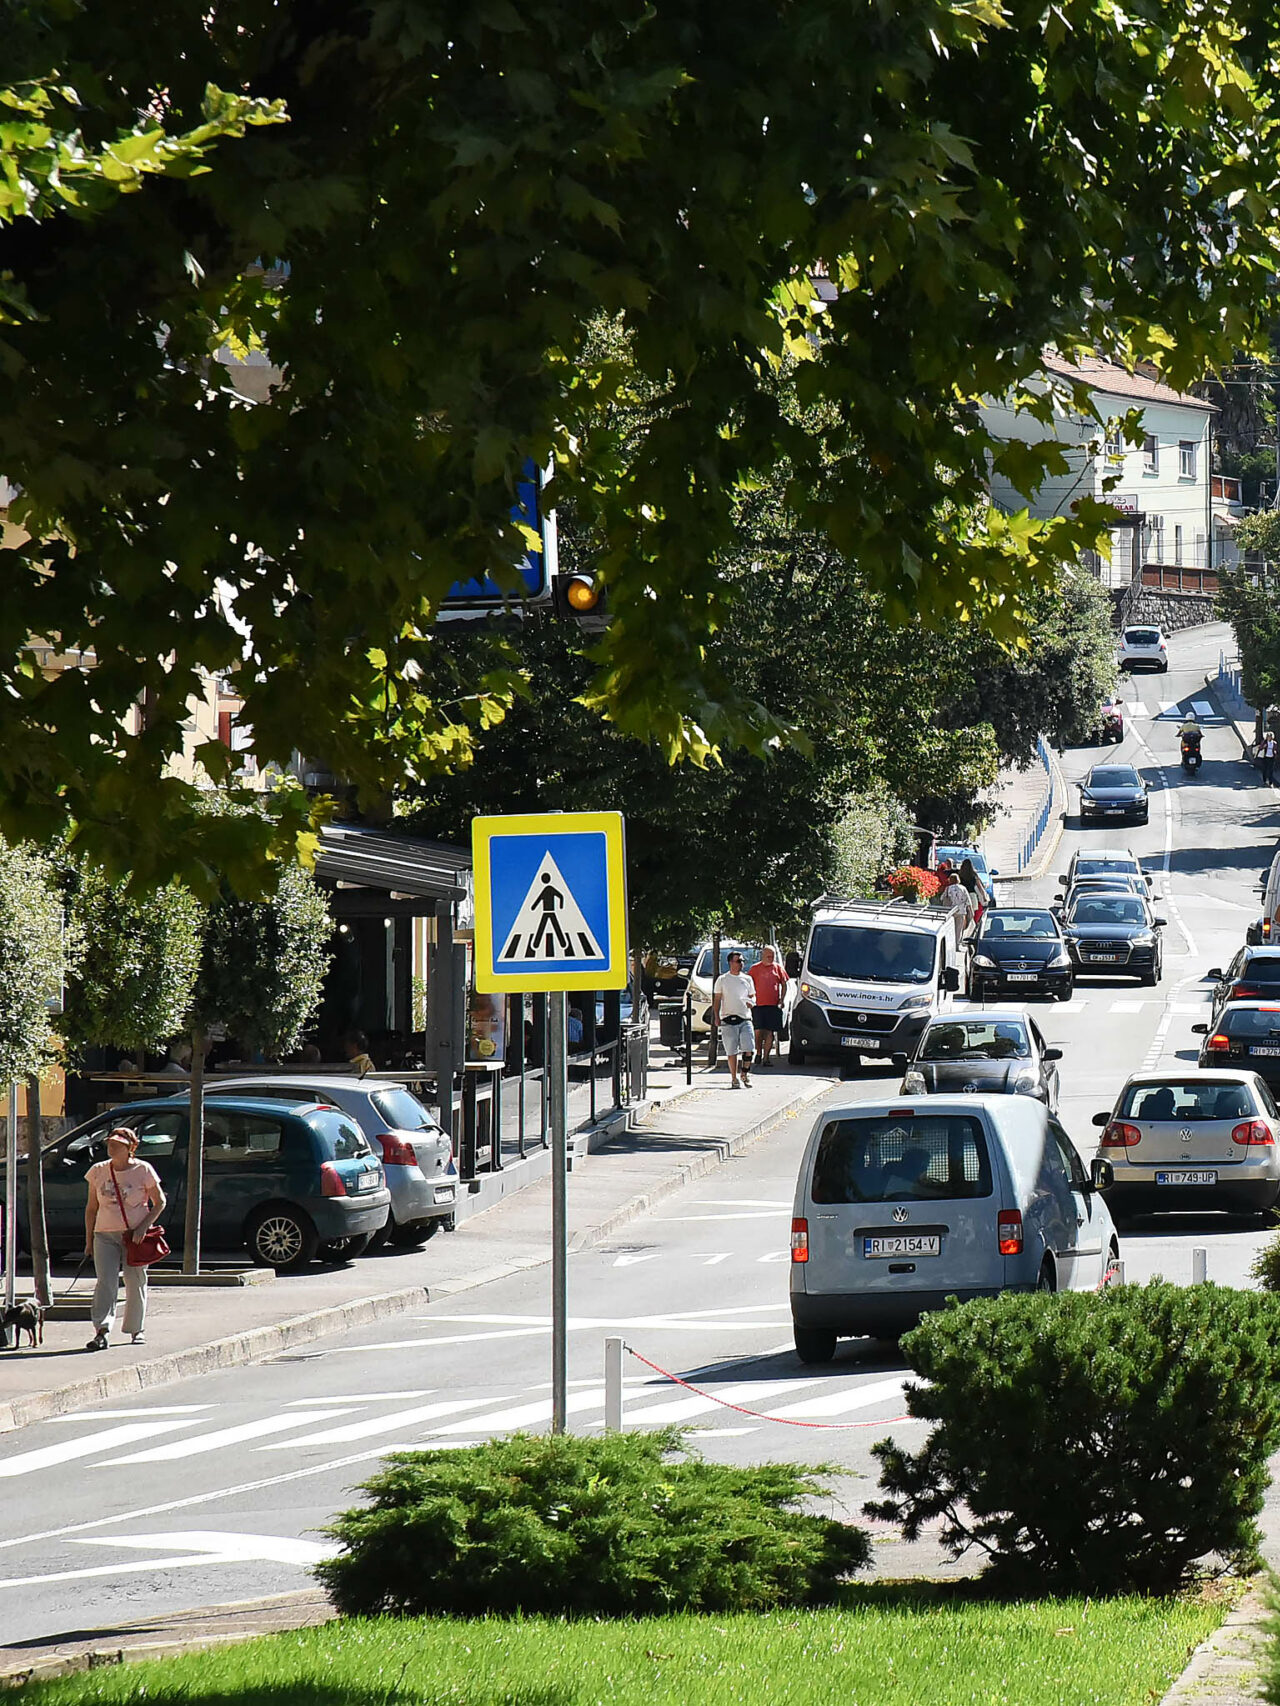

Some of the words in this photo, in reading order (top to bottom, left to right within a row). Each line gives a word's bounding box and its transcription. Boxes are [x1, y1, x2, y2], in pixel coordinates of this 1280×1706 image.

[836, 992, 894, 1002] www.inox-s.hr
[1164, 1174, 1173, 1183] RI
[1181, 1173, 1214, 1183] 749-UP
[872, 1239, 885, 1253] RI
[895, 1238, 936, 1252] 2154-V
